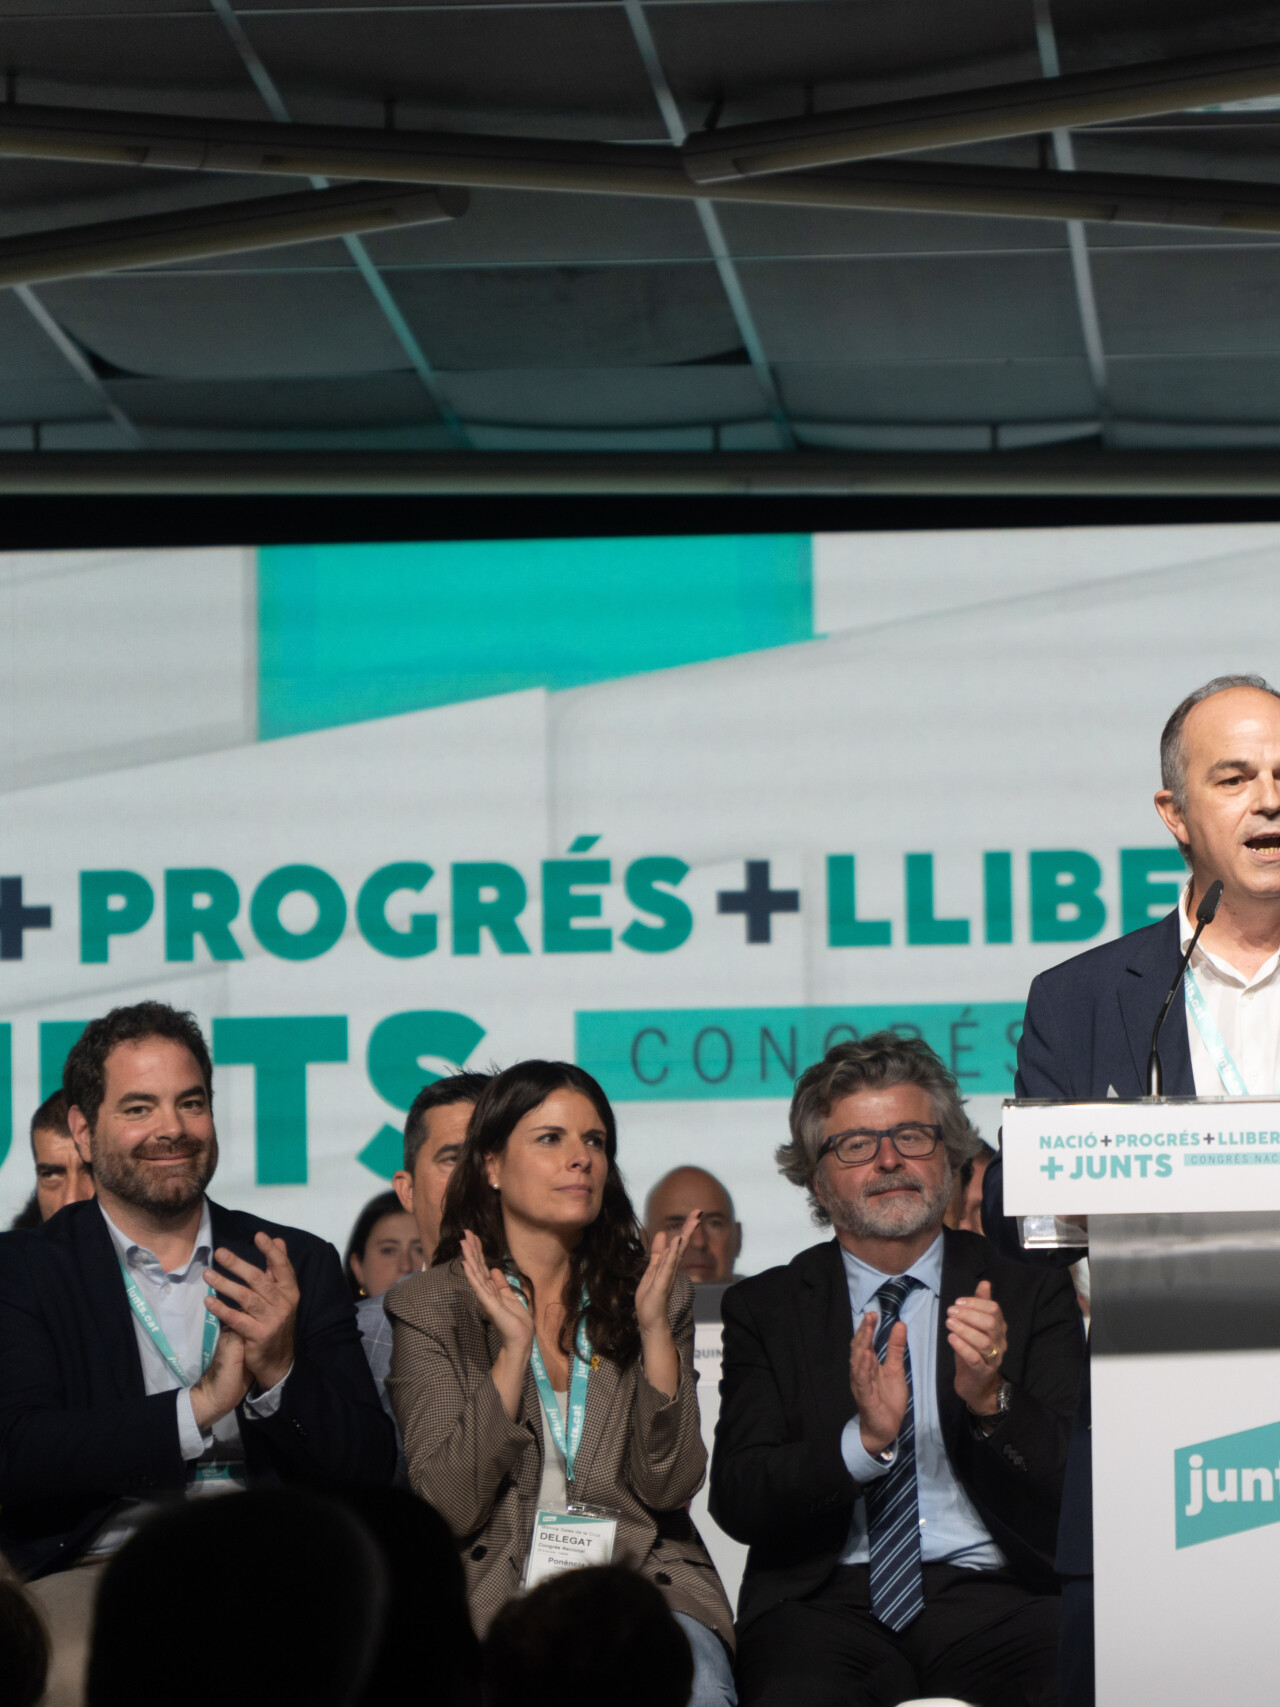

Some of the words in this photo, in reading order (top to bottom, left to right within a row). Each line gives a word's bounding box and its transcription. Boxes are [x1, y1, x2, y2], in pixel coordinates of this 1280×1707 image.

[80, 835, 694, 963] PROGRÉS
[1039, 1131, 1098, 1150] NACIÓ
[1115, 1130, 1201, 1148] PROGRÉS
[1069, 1153, 1173, 1180] JUNTS
[1190, 1152, 1249, 1165] CONGRÉS
[126, 1284, 159, 1332] junts.cat
[540, 1532, 592, 1547] DELEGAT
